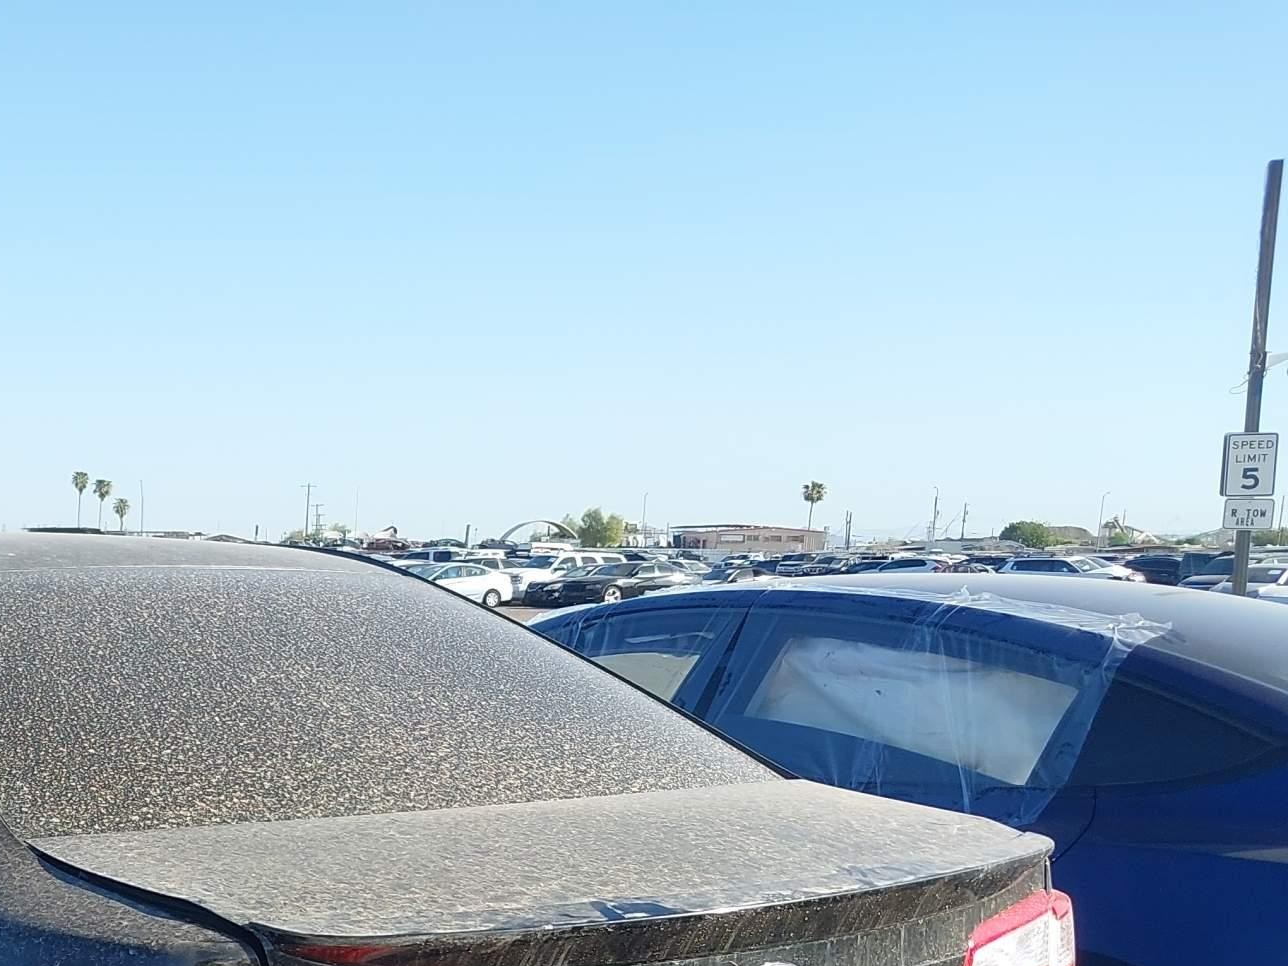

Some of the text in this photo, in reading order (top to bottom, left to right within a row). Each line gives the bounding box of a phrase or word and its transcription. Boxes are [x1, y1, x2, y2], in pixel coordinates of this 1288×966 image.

[1232, 440, 1274, 450] SPEED
[1235, 453, 1269, 463] LIMIT
[1240, 467, 1260, 490] 5
[1246, 508, 1266, 518] TOW
[1236, 518, 1254, 526] AREA
